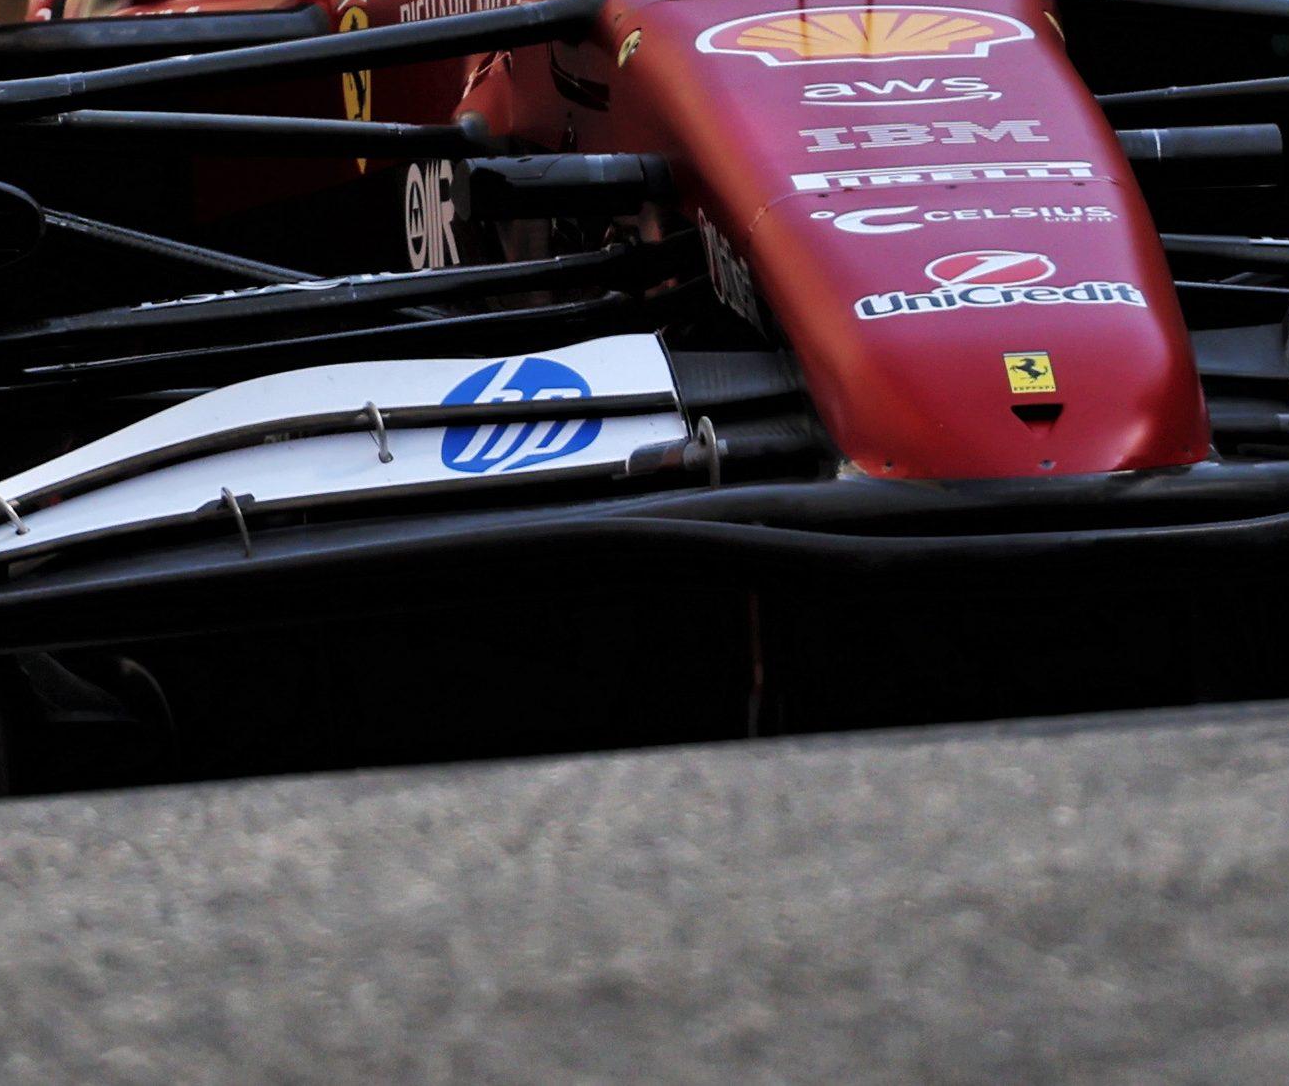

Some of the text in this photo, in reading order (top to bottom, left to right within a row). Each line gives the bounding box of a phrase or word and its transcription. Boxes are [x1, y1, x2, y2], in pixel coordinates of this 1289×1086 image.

[803, 76, 992, 101] aws
[799, 119, 1050, 153] IBM
[791, 161, 1093, 191] PIRELLI
[923, 206, 1113, 222] CELSIUS
[857, 282, 1147, 320] UniCredit
[453, 357, 584, 473] hp
